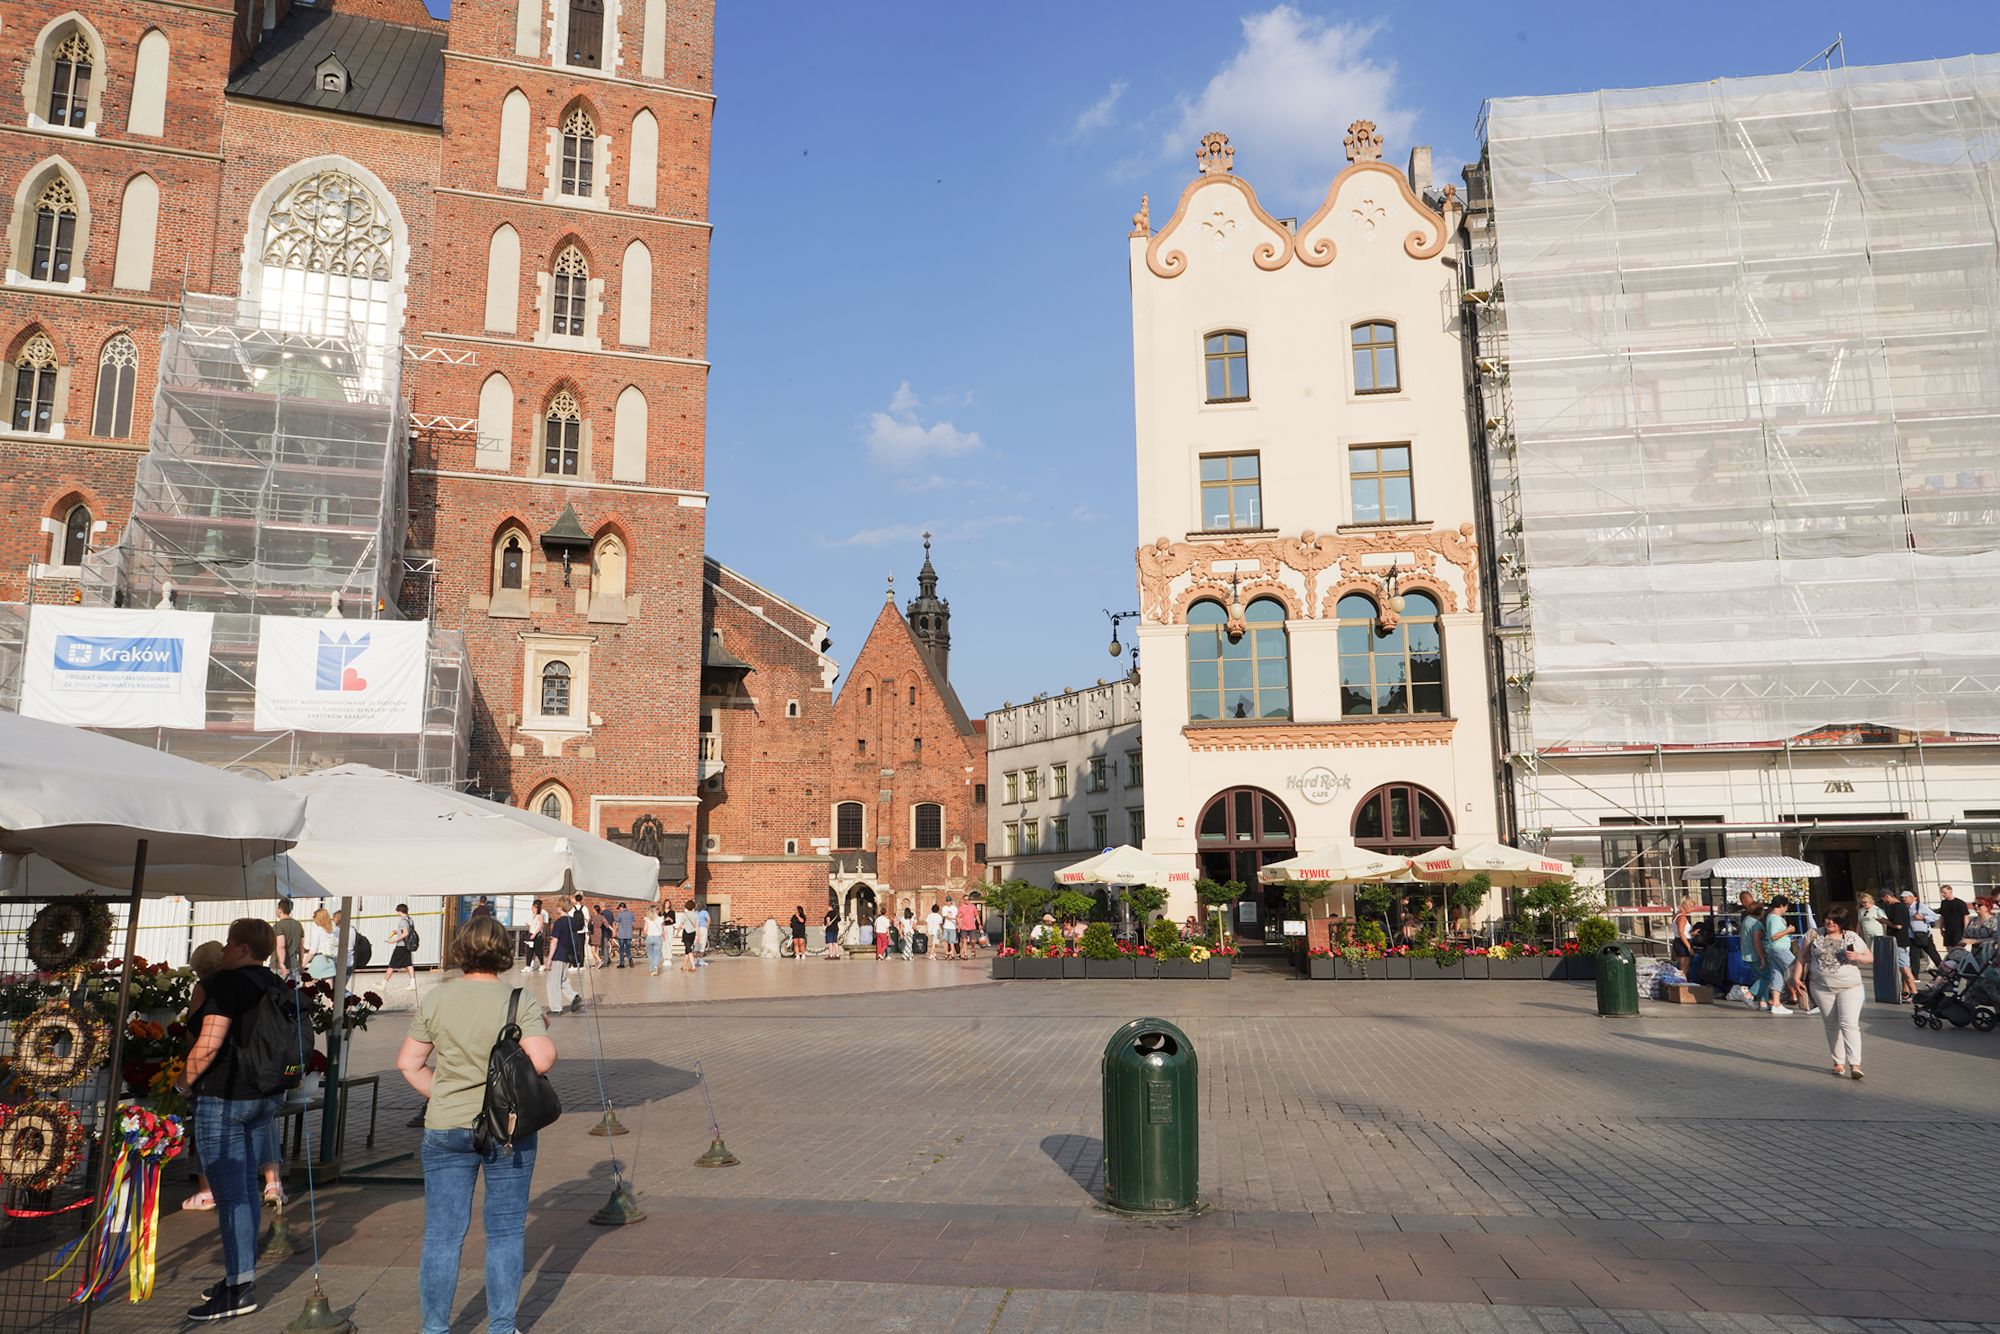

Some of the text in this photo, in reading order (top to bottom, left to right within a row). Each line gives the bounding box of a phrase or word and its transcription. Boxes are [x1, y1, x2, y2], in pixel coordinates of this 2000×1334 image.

[99, 645, 170, 662] Kraków
[1286, 773, 1352, 790] Hard Rock
[1824, 780, 1855, 793] ZARA
[1425, 857, 1451, 870] ŻYWIEC
[1063, 872, 1085, 882] ŻYWIEC
[1168, 872, 1190, 882] ŻYWIEC
[1299, 868, 1330, 878] ŻYWIEC
